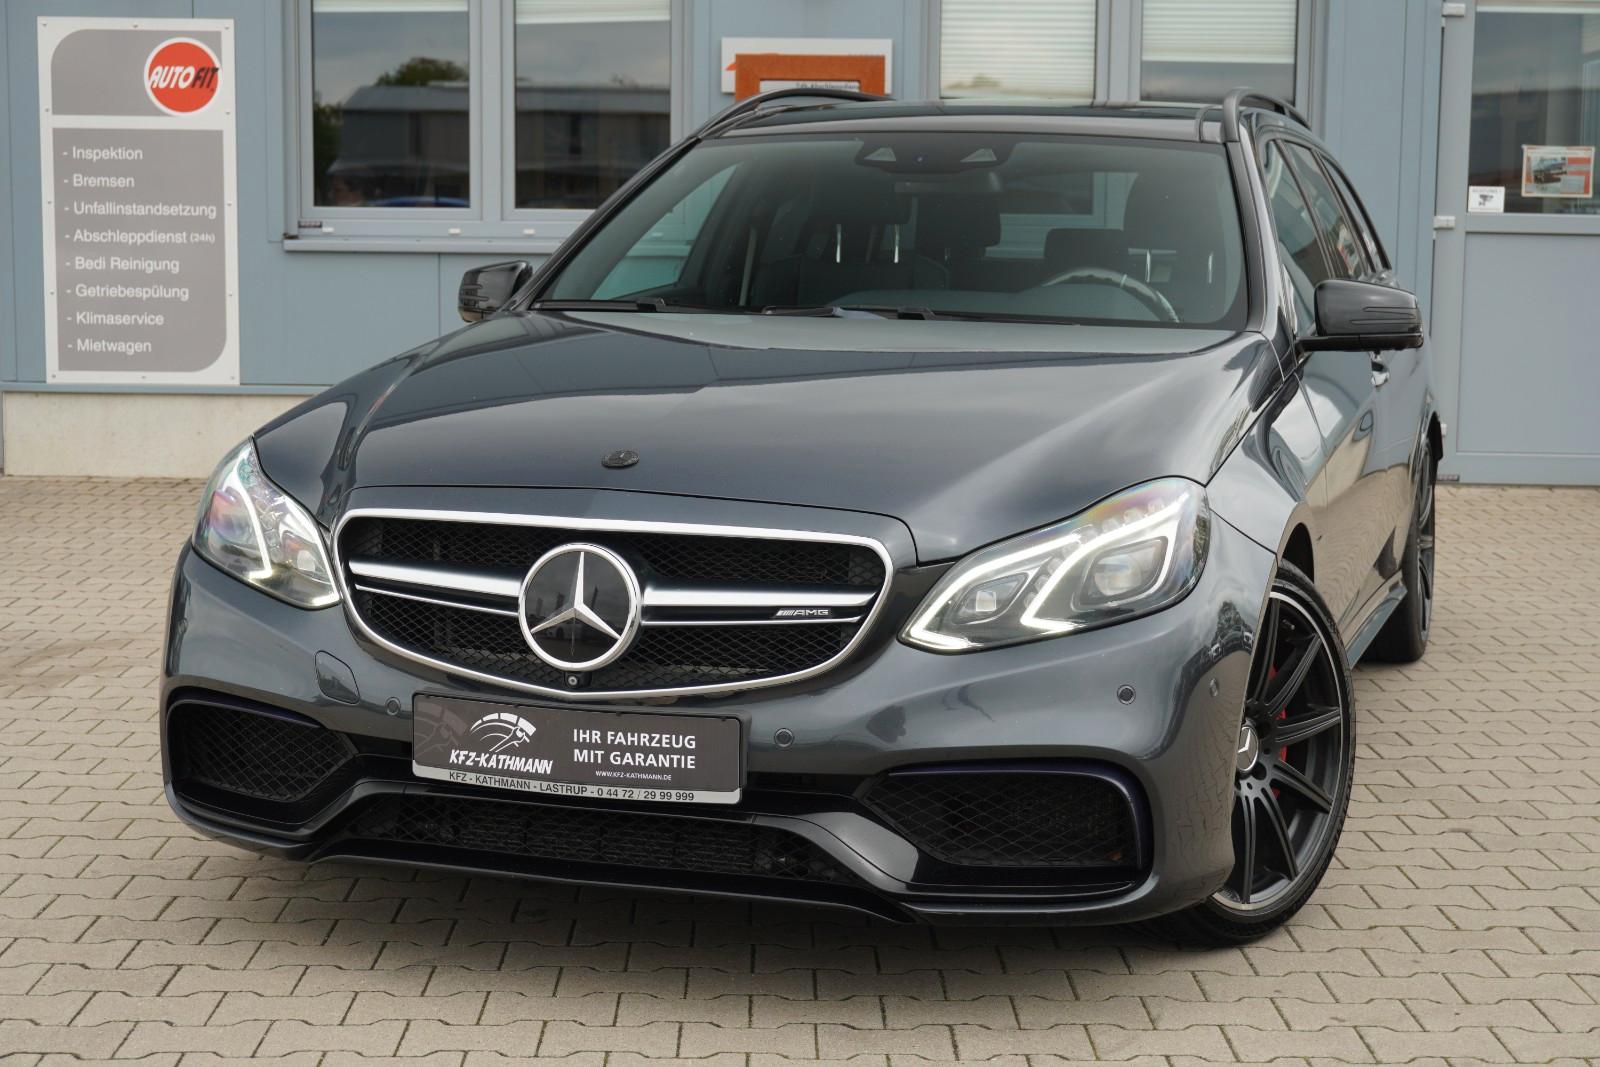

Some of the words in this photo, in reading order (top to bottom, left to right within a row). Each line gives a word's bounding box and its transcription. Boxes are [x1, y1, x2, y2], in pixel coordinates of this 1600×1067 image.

[72, 146, 143, 162] Inspektion
[72, 173, 135, 188] Bremsen
[73, 201, 217, 219] Unfallinstandsetzung
[73, 229, 187, 246] Abschleppdienst
[74, 256, 106, 270] Bedi
[110, 256, 180, 274] Reinigung
[75, 283, 190, 301] Getriebespülung
[76, 311, 165, 326] Klimaservice
[76, 338, 152, 355] Mietwagen
[573, 728, 602, 744] IHR
[607, 731, 696, 749] FAHRZEUG
[449, 749, 553, 774] KFZ-KATHMANN
[573, 748, 604, 764] MIT
[609, 751, 696, 769] GARANTIE
[595, 770, 672, 781] WWW.KFZ-KATHMANN.DE
[449, 771, 467, 782] KFZ
[475, 774, 531, 790] KATHMANN
[540, 782, 588, 795] LASTRUP
[597, 787, 603, 797] 0
[606, 788, 618, 798] 44
[621, 789, 634, 799] 72
[643, 790, 656, 800] 29
[659, 791, 672, 800] 99
[675, 792, 695, 801] 999
